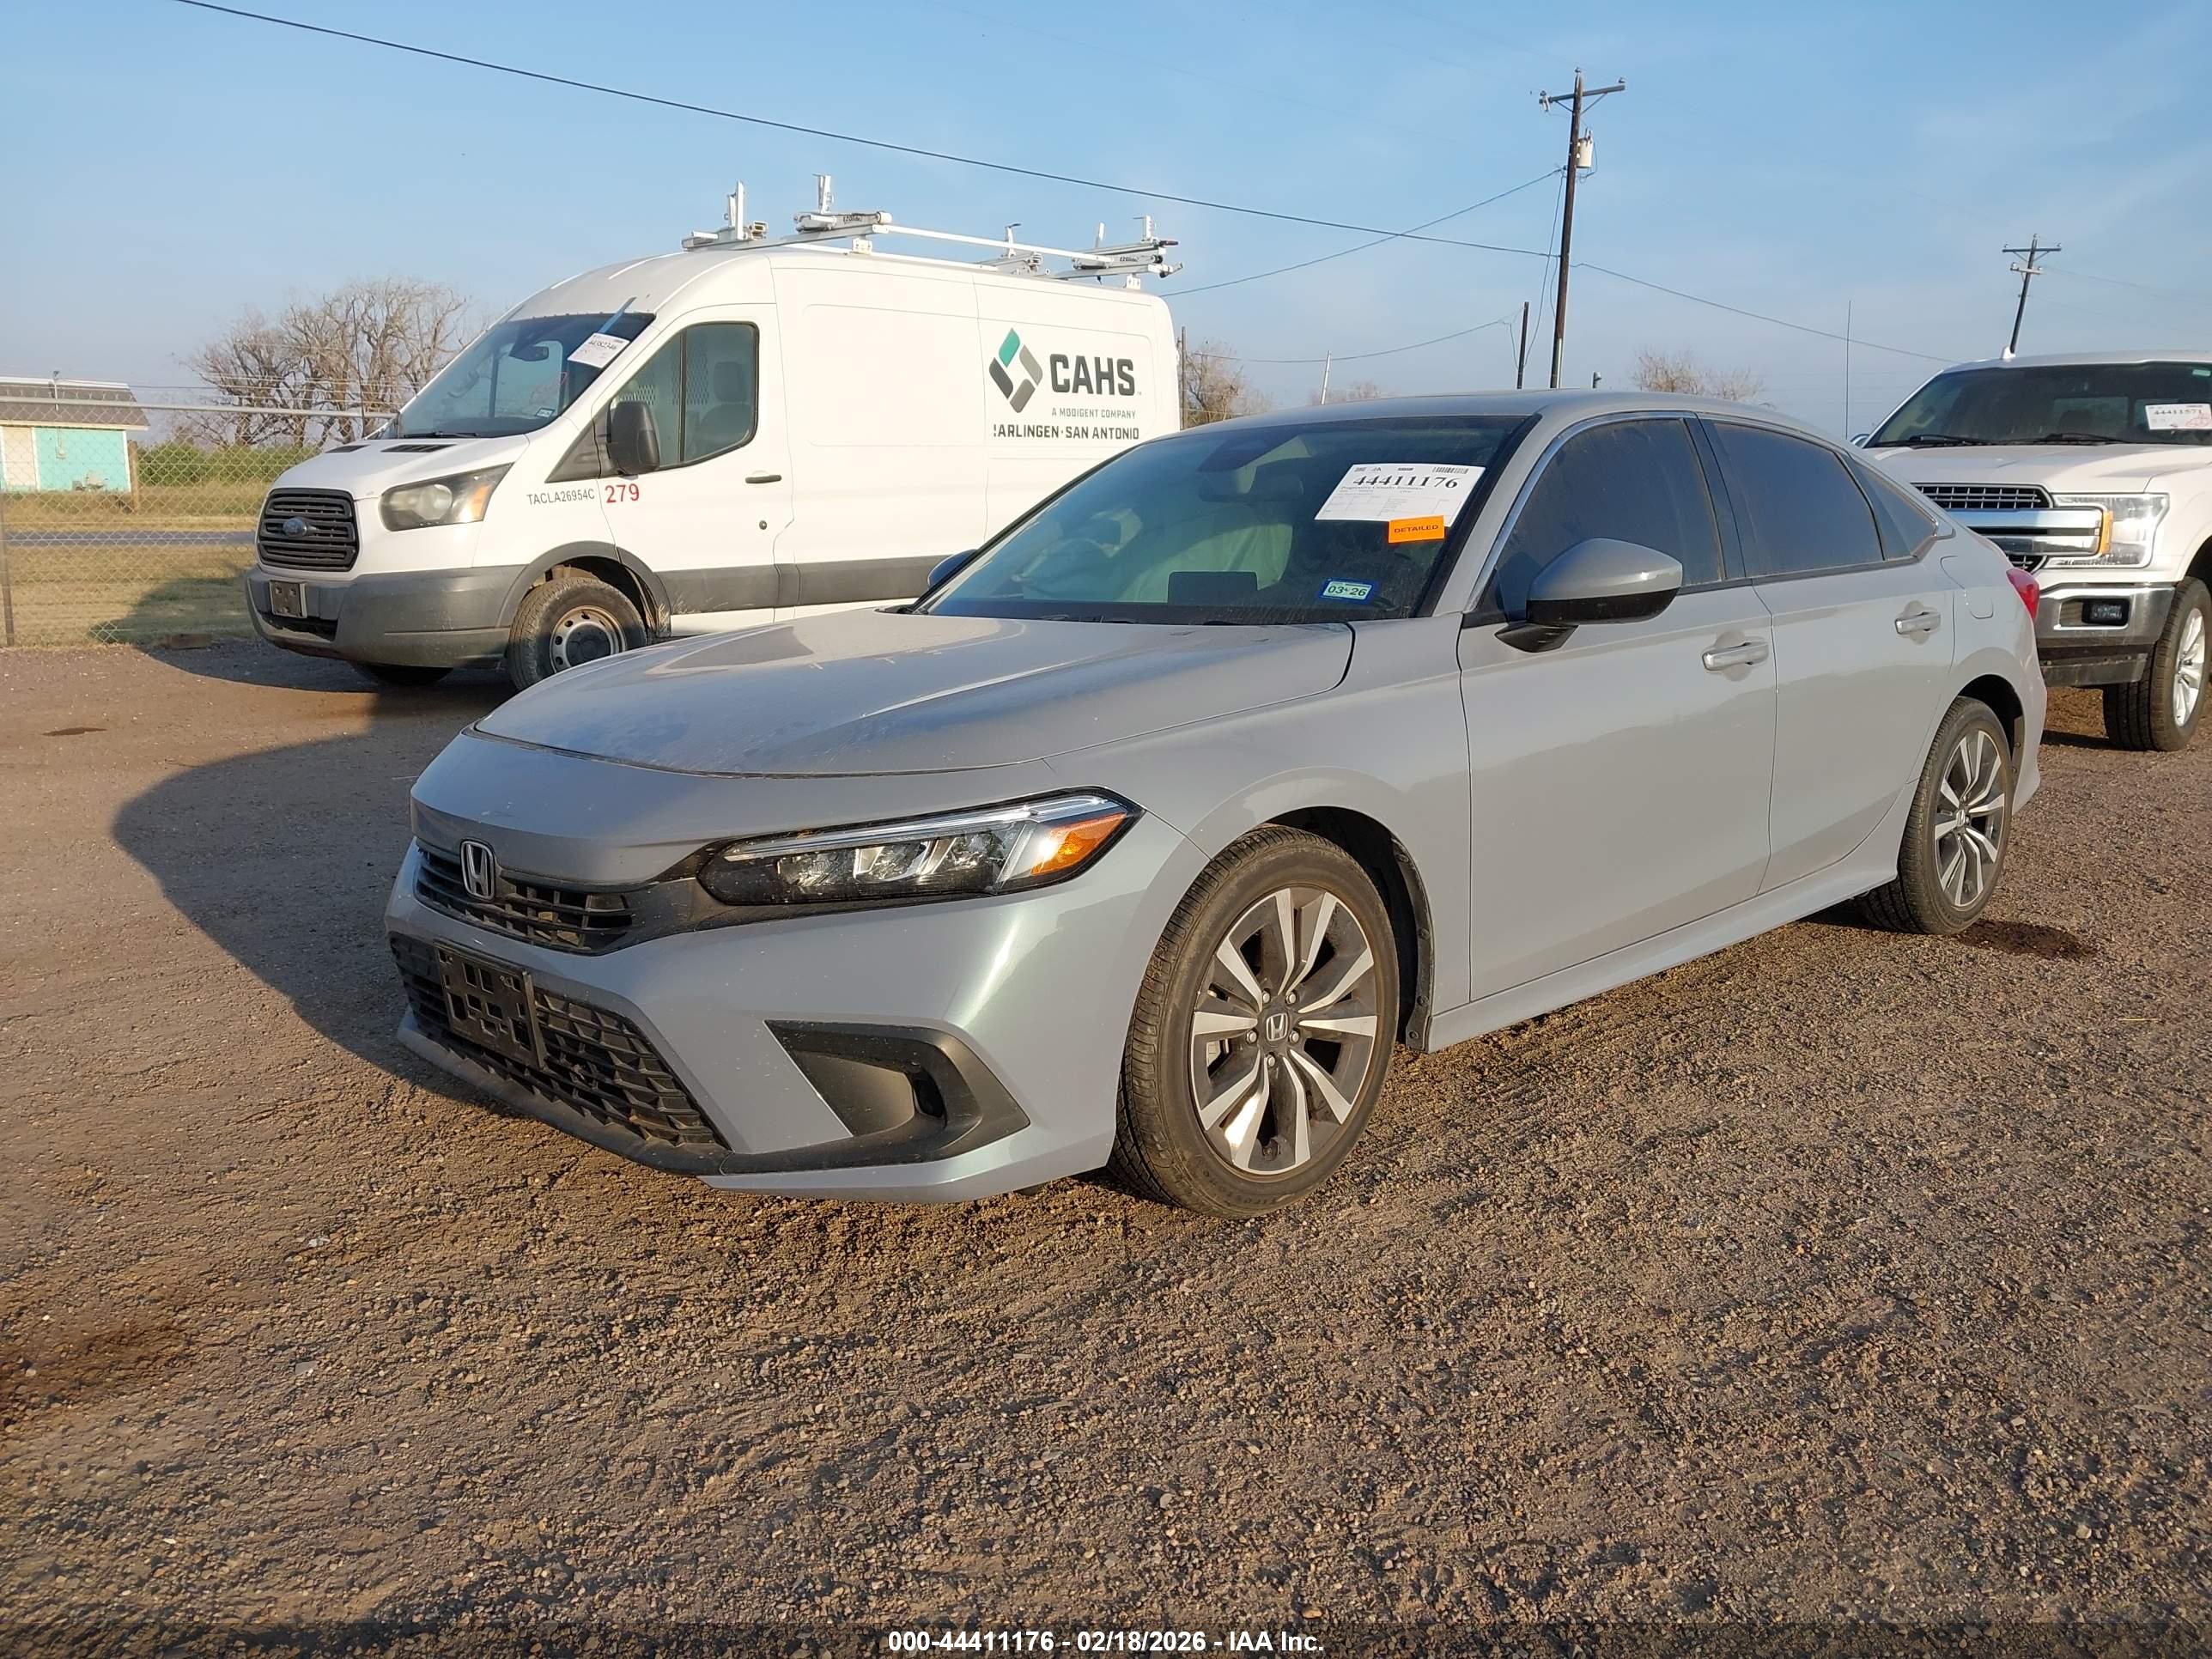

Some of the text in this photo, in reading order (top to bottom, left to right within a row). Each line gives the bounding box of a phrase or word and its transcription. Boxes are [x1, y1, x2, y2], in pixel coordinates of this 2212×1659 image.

[1050, 353, 1135, 396] CAHS
[1052, 407, 1136, 419] A MODIGENT COMPANY
[1066, 426, 1089, 439] SAN
[1092, 427, 1139, 440] ANTONIO
[1352, 476, 1462, 489] 44411176
[526, 488, 595, 506] TACLA26954C
[605, 483, 640, 503] 279
[1394, 524, 1439, 533] DETAILED
